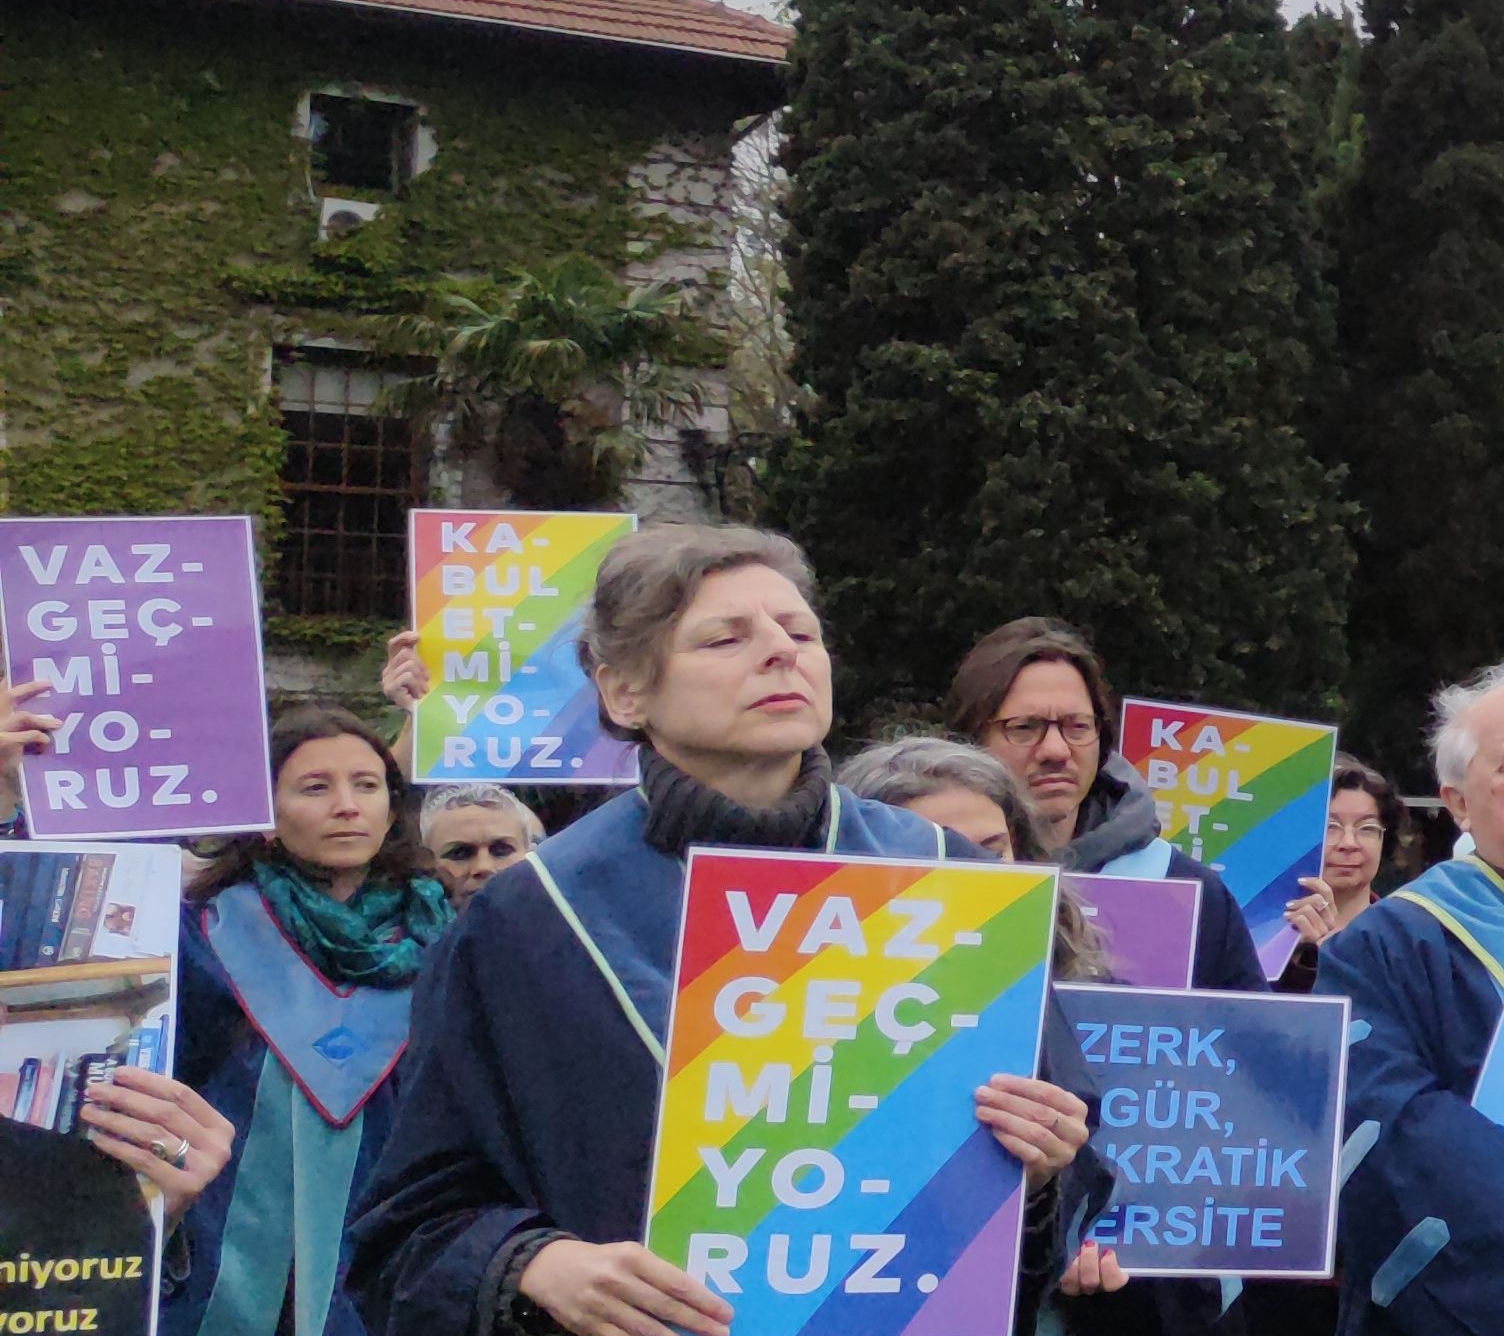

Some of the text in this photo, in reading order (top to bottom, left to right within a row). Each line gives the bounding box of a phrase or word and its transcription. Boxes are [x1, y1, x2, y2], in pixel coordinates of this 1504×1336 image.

[440, 521, 550, 554] KA-
[18, 543, 204, 585] VAZ-
[441, 564, 560, 597] BUL
[27, 597, 214, 647] GEÇ-
[442, 607, 537, 640] ET-
[32, 642, 154, 698] Mİ-
[442, 640, 538, 683] Mİ-
[36, 710, 172, 755] YO-
[442, 694, 551, 725] YO-
[443, 735, 584, 768] RUZ.
[1151, 718, 1251, 756] KA-
[44, 764, 219, 810] RUZ.
[1148, 758, 1254, 802] BUL
[724, 889, 983, 959] VAZ-
[713, 976, 980, 1055] GEÇ-
[1076, 1022, 1237, 1076] ZERK,
[703, 1044, 880, 1125] Mİ-
[1099, 1079, 1235, 1139] GÜR,
[696, 1147, 891, 1210] YO-
[1105, 1137, 1309, 1188] KRATİK
[1087, 1195, 1286, 1247] ERSİTE
[685, 1232, 940, 1295] RUZ.
